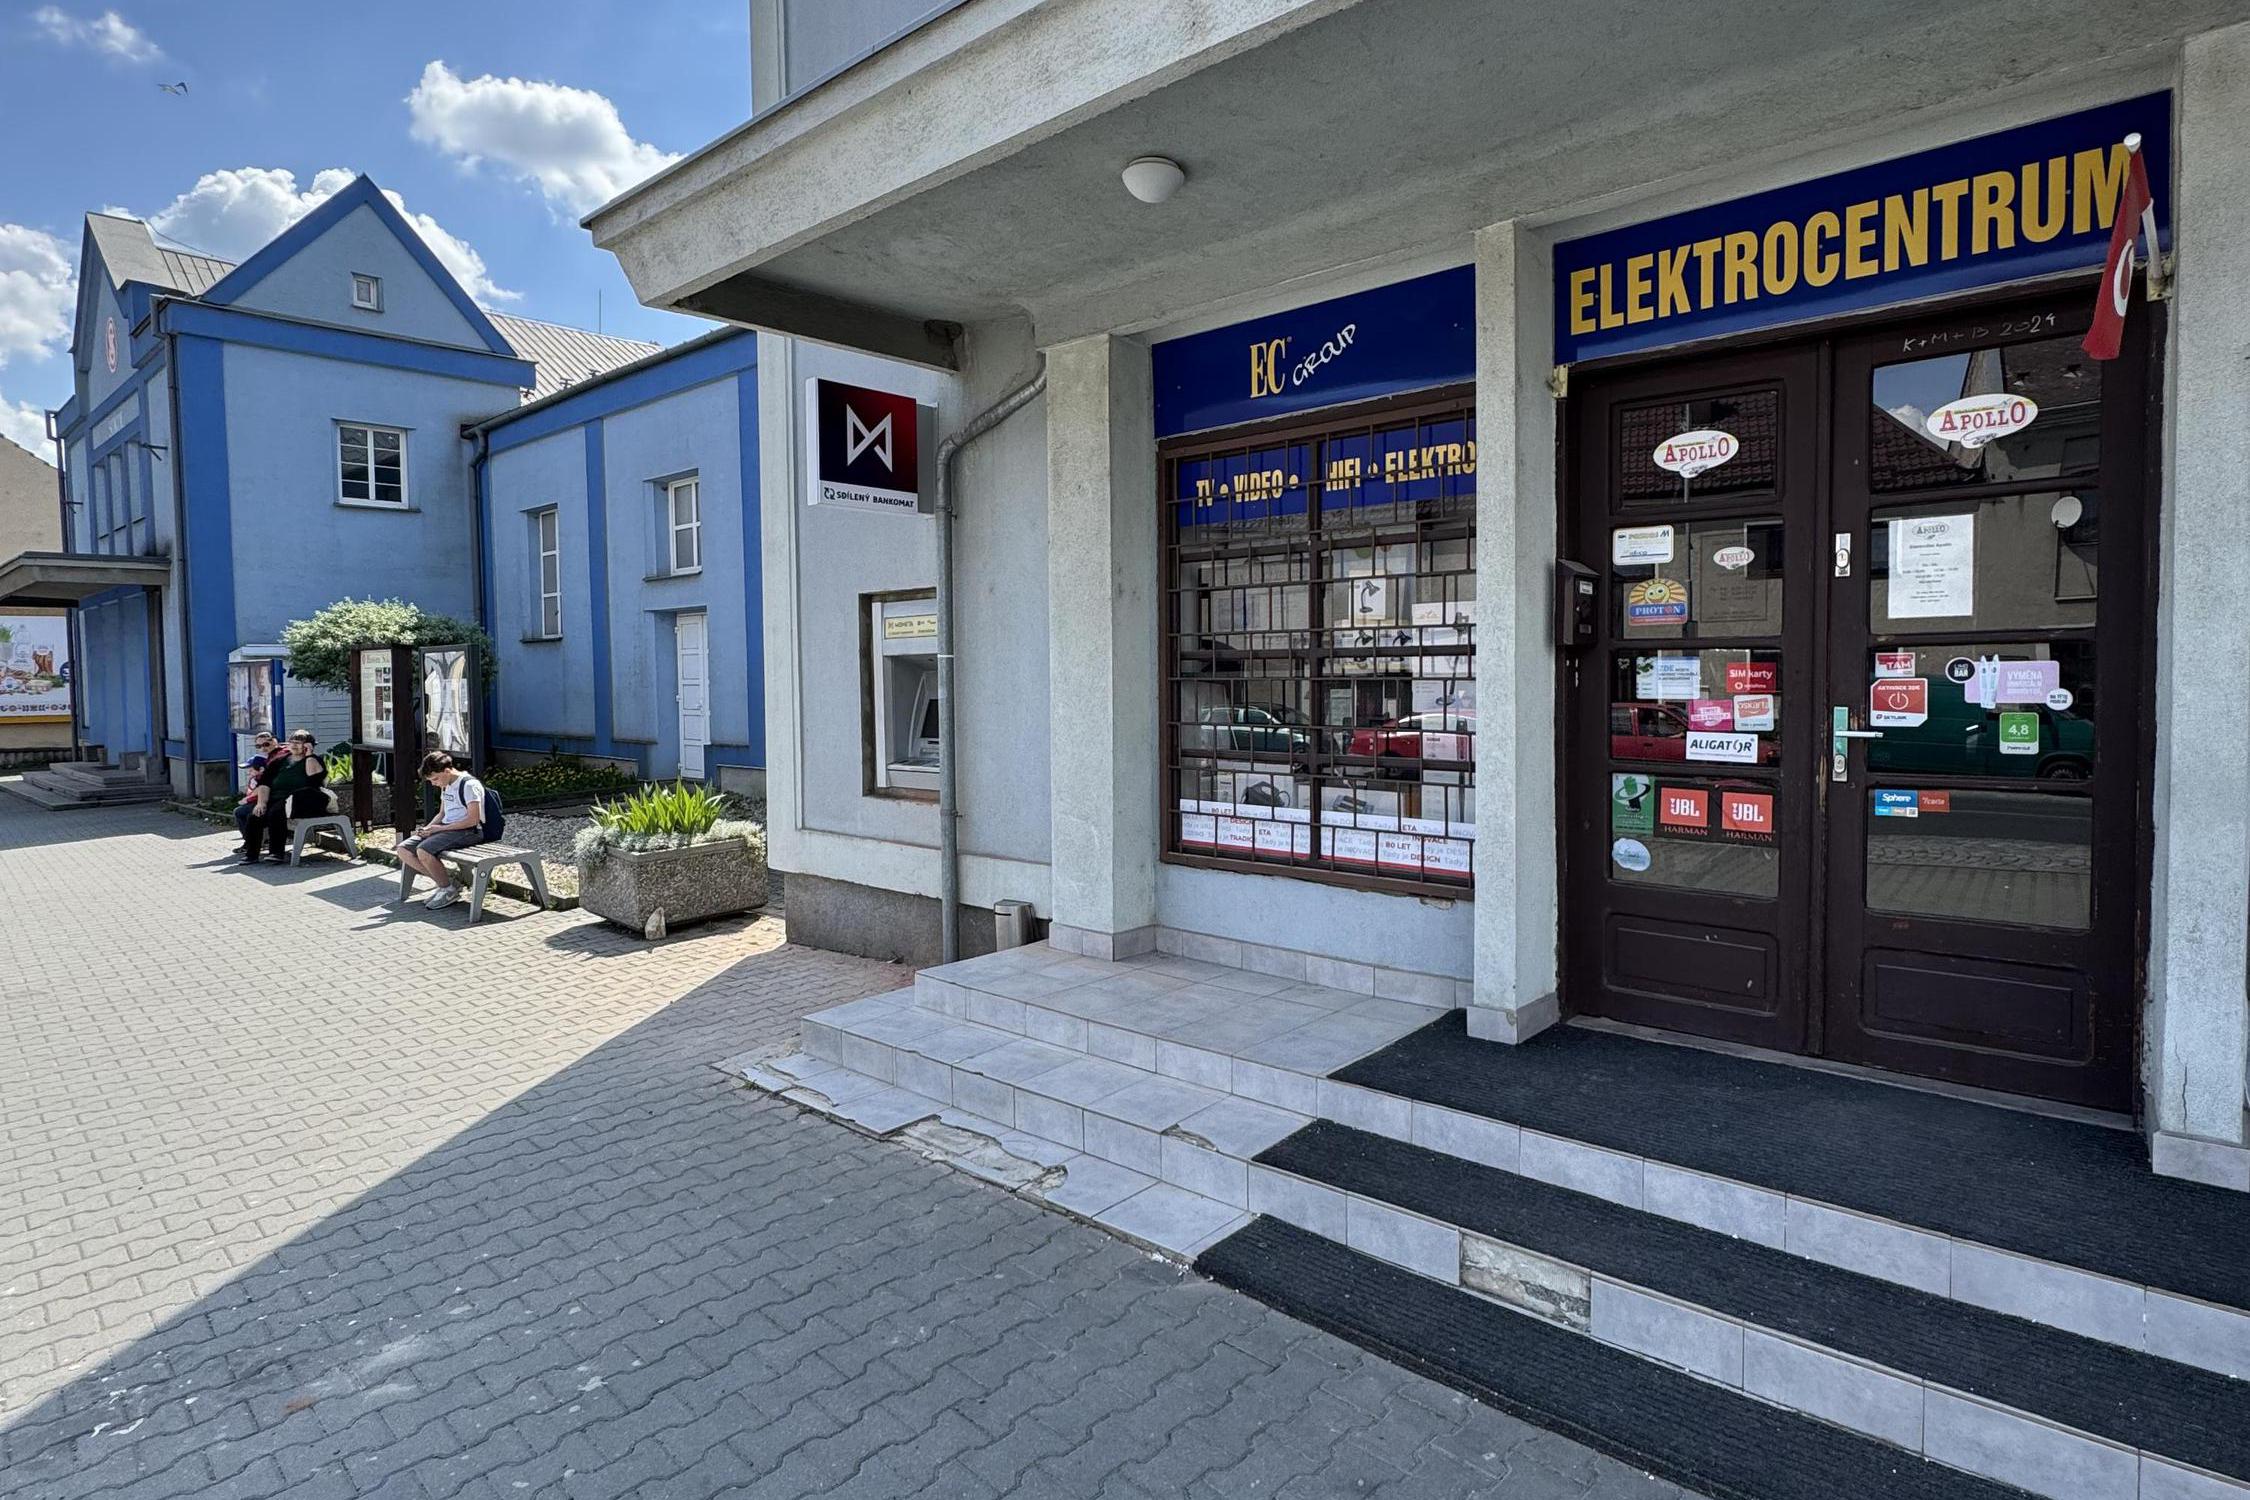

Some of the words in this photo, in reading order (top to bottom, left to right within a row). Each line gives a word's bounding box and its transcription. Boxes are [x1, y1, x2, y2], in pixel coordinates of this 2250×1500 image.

[1569, 142, 2130, 336] ELEKTROCENTRUM
[1249, 338, 1286, 399] EC
[1939, 400, 2027, 433] APOLLO
[1663, 437, 1730, 464] APOLLO
[1196, 479, 1214, 507] TV
[1234, 469, 1284, 503] VIDEO
[1325, 457, 1361, 492] HIFI
[1385, 440, 1477, 485] ELEKTRO
[835, 489, 871, 503] SDÍLENÝ
[872, 495, 915, 509] BANKOMAT
[1635, 605, 1682, 616] PROTON
[1729, 669, 1747, 678] SIM
[1748, 669, 1773, 681] karty
[1670, 798, 1700, 817] JBL
[1881, 793, 1912, 804] Sphere
[1732, 802, 1764, 823] JBL
[1402, 823, 1418, 832] ETA
[1664, 825, 1708, 836] HARMAN
[1725, 831, 1773, 842] HARMAN
[1396, 843, 1412, 851] LET
